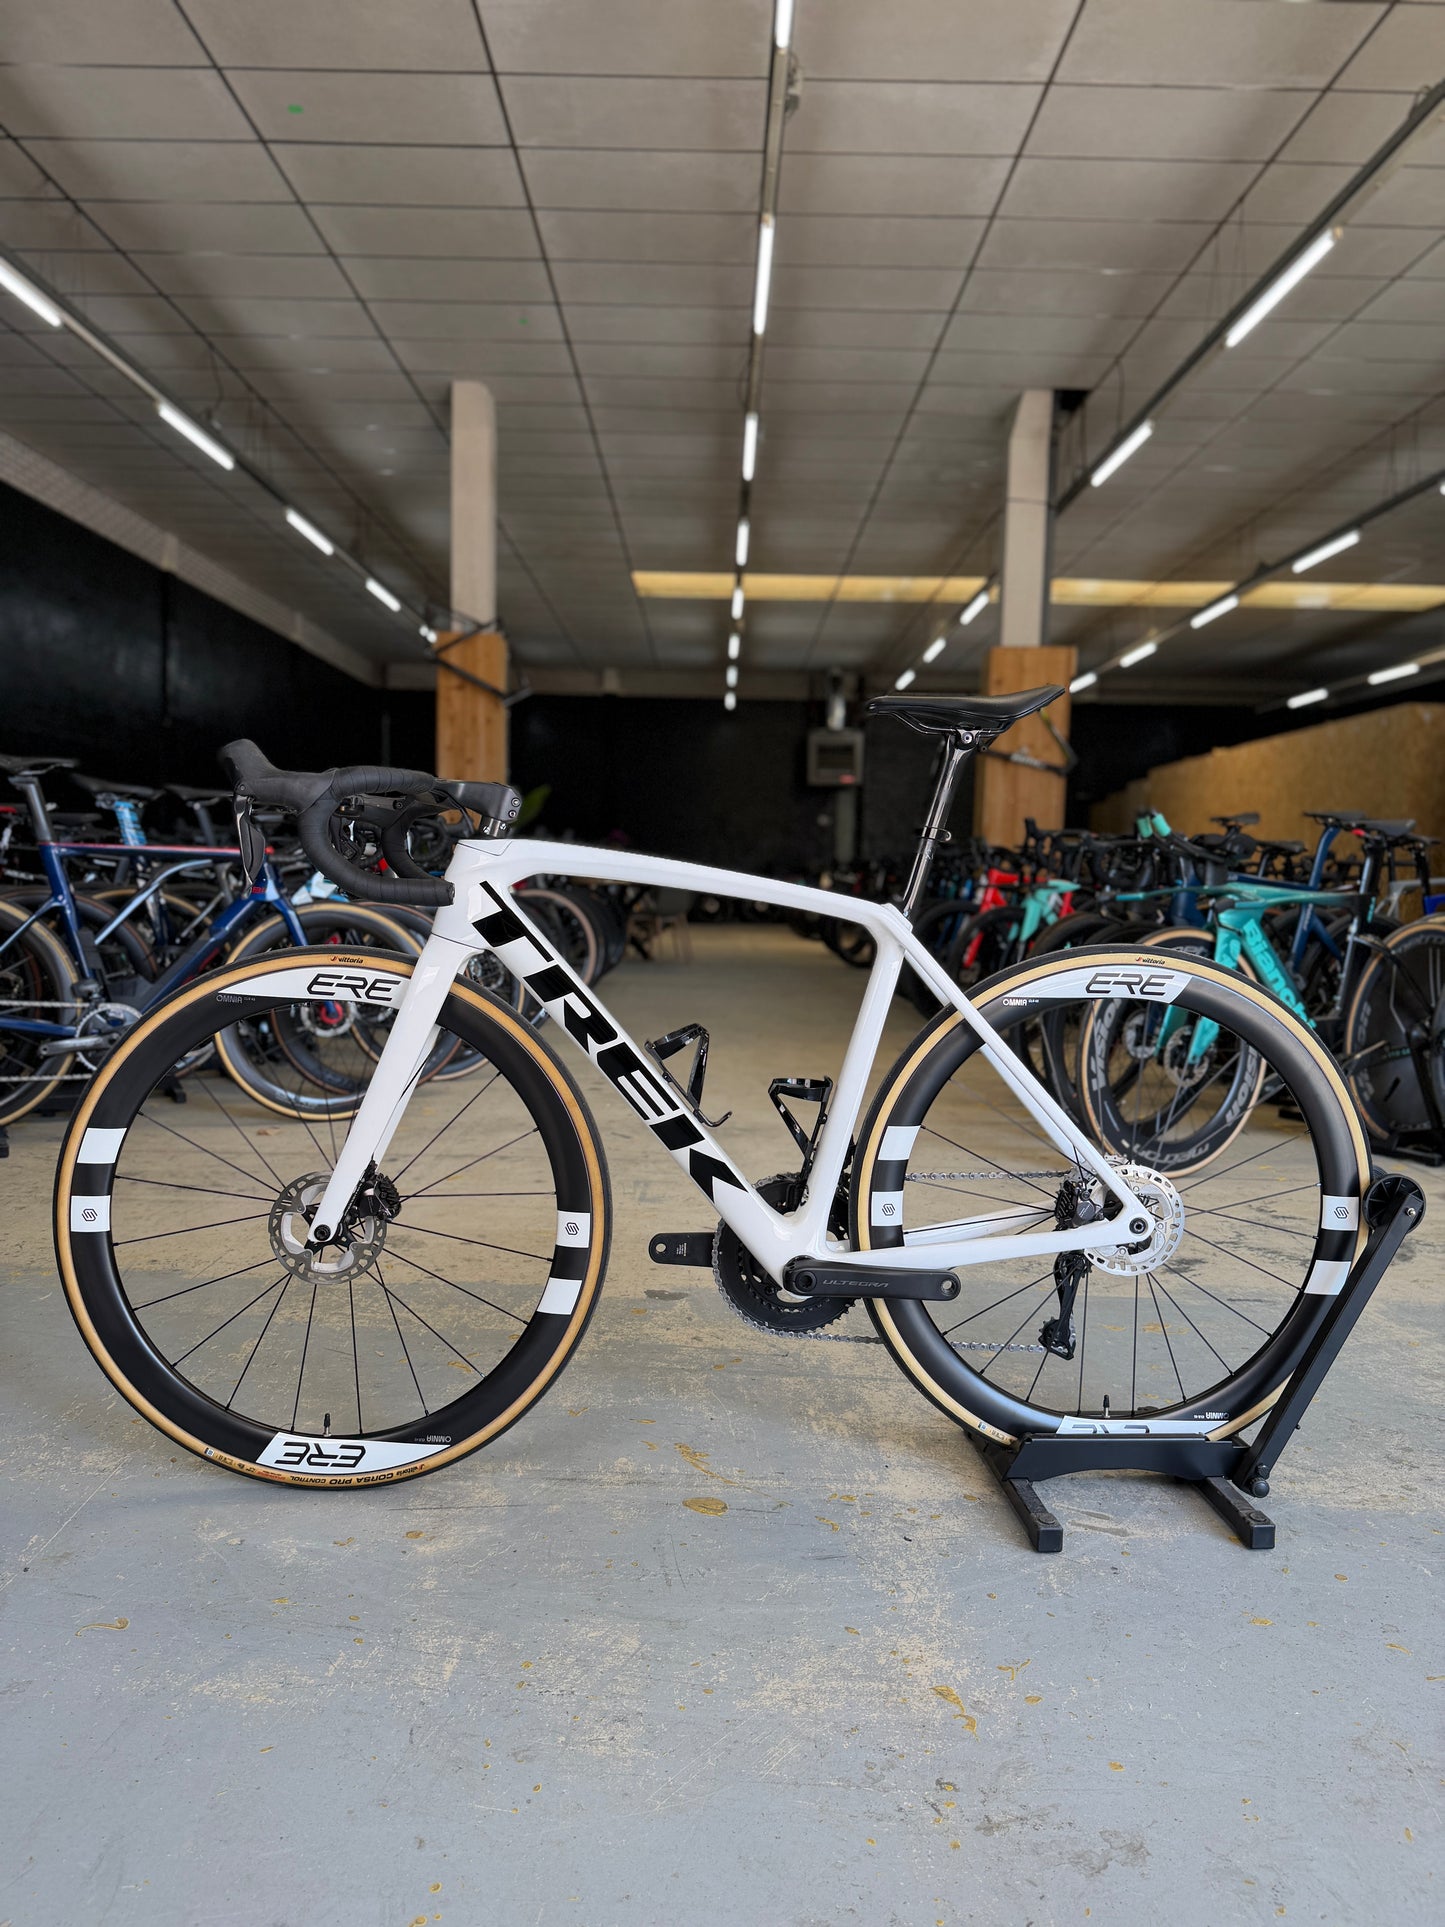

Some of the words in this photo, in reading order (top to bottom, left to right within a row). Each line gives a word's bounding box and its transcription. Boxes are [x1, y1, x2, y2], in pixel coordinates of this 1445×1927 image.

[338, 956, 364, 964] vittoria
[1241, 919, 1317, 1029] Bianch
[307, 973, 401, 1001] ERE
[1085, 972, 1175, 996] ERE
[216, 994, 243, 1004] OMNIA
[1002, 998, 1027, 1006] OMNIA
[470, 880, 748, 1204] TREK
[822, 1279, 889, 1288] ULTEGRA
[1205, 1412, 1230, 1420] OMNIA
[427, 1435, 452, 1443] OMNIA
[274, 1441, 366, 1468] ERE
[396, 1466, 418, 1476] vittoria
[290, 1476, 327, 1484] CONTROL
[356, 1472, 394, 1483] CORSA
